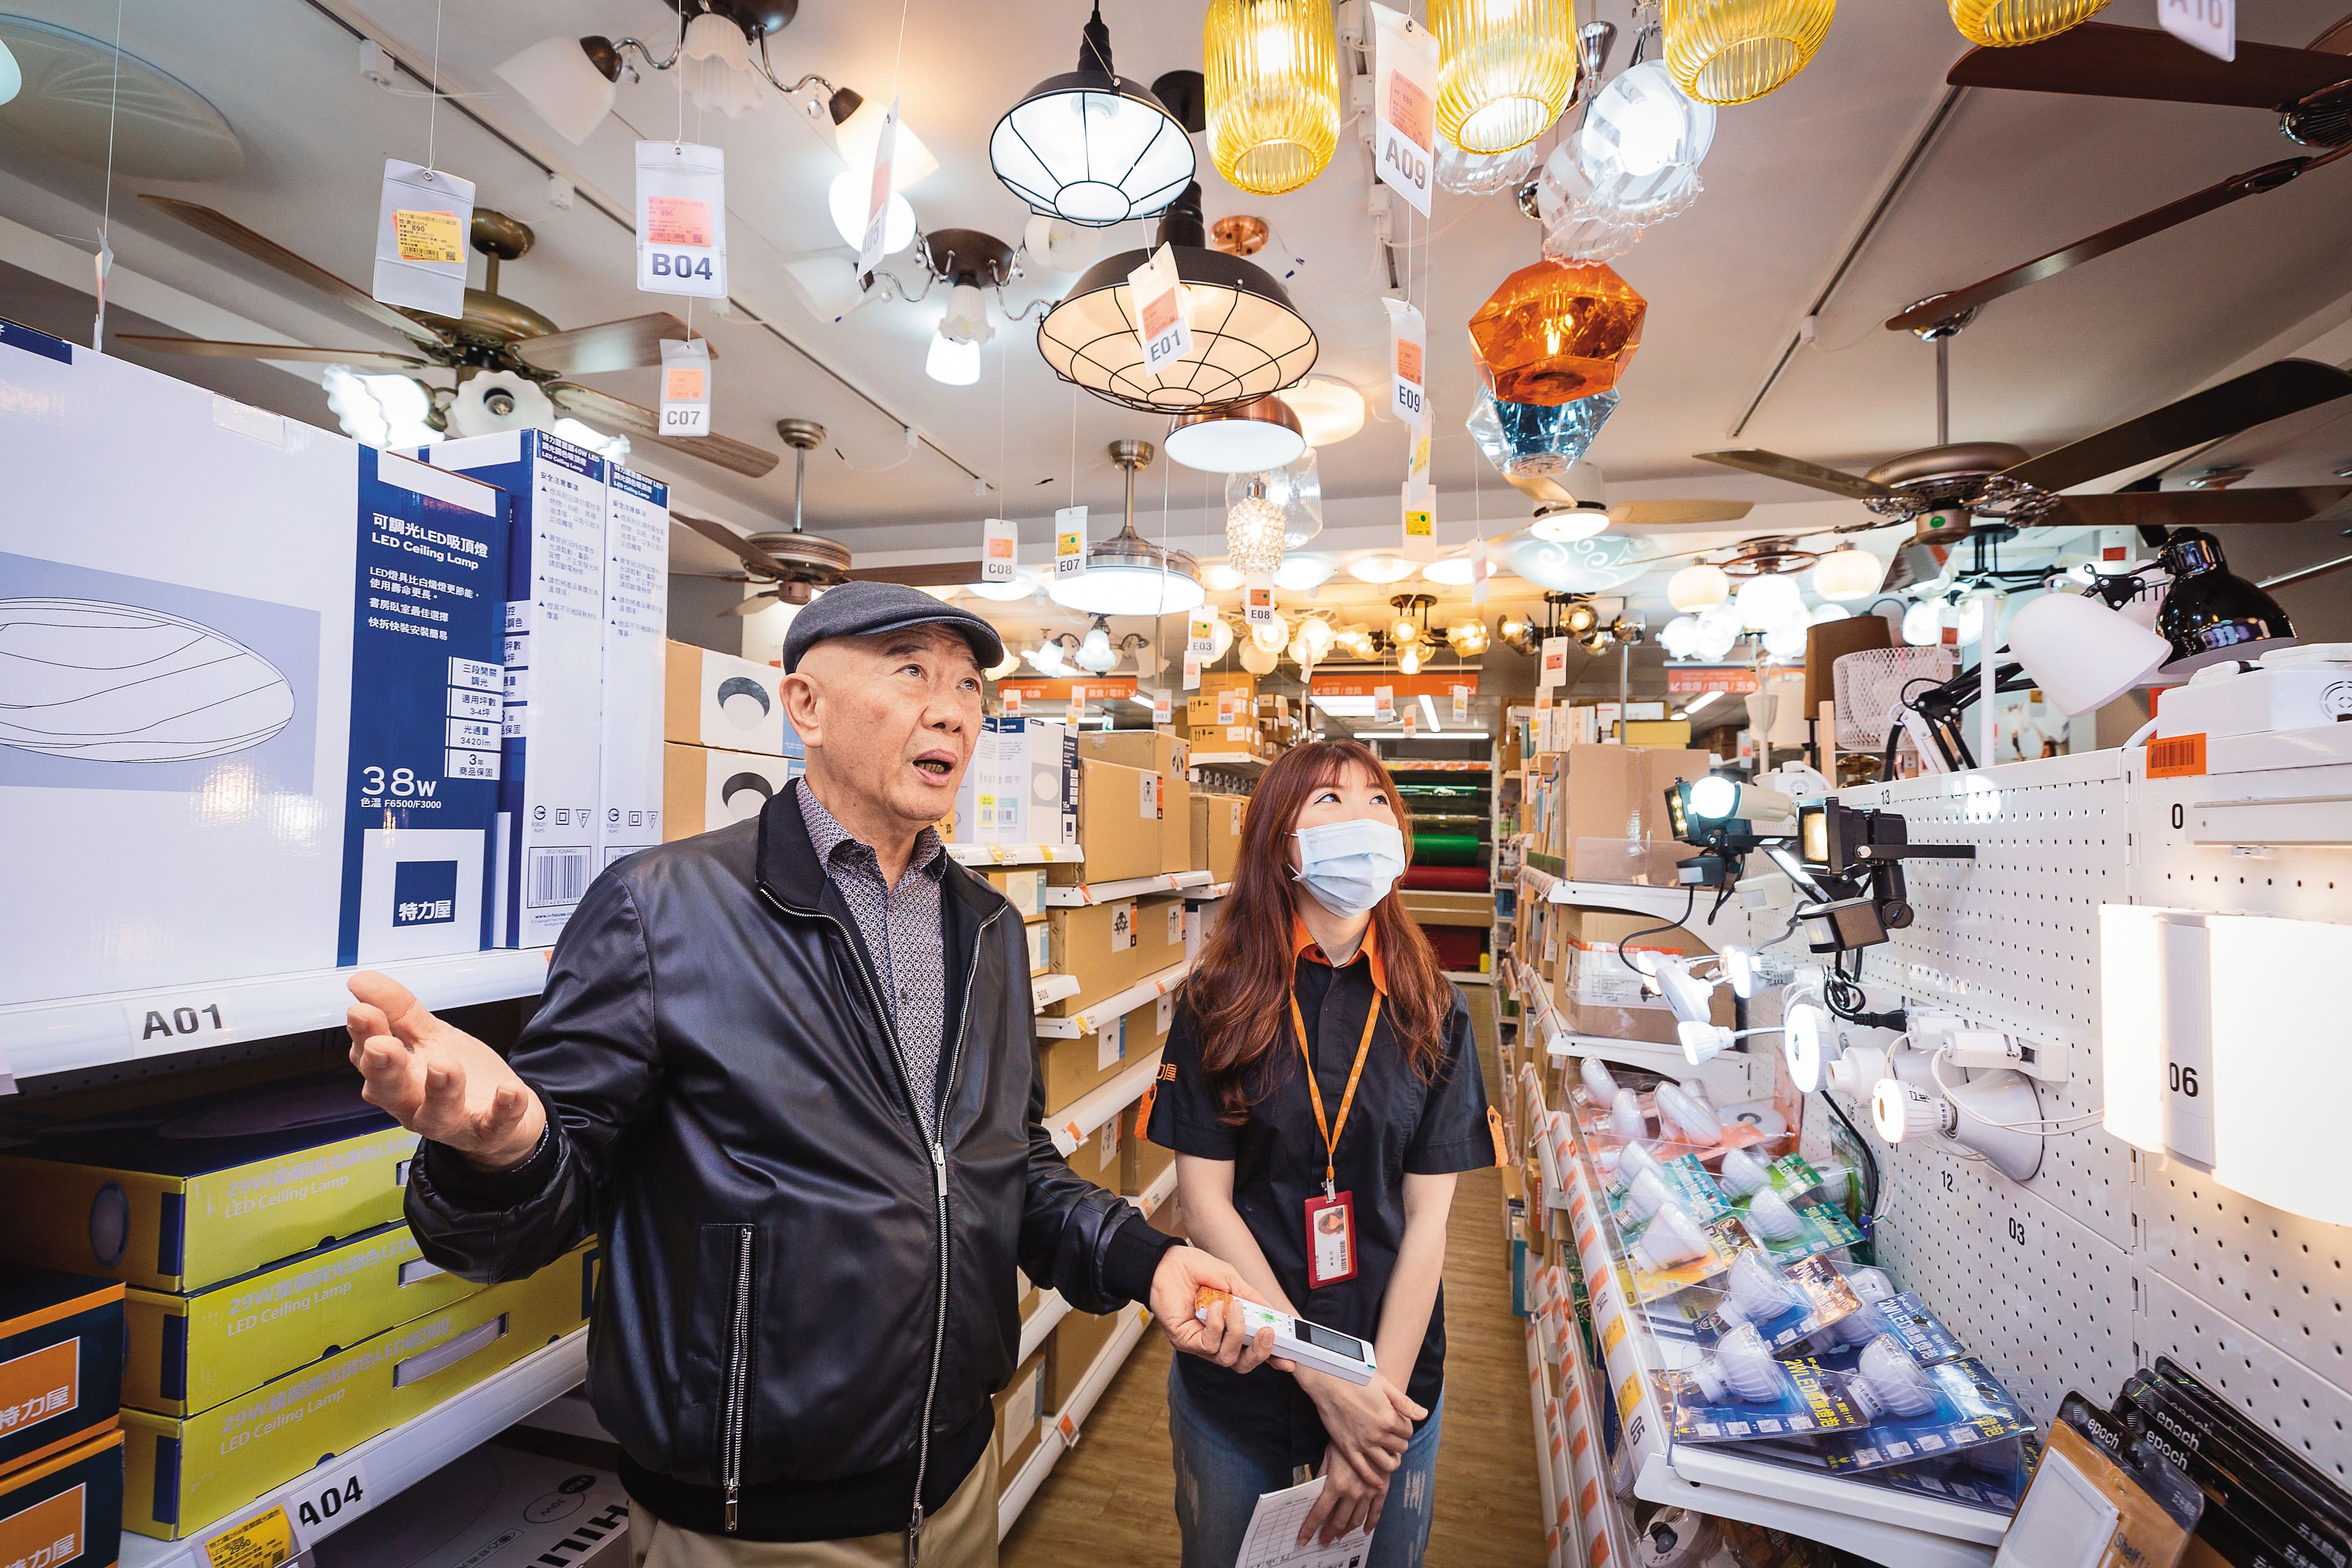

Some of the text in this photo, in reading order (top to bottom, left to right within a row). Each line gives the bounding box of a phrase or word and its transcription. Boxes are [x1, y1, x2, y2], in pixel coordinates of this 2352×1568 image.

[1385, 137, 1427, 190] A09
[652, 253, 713, 281] B04
[1150, 329, 1180, 362] E01
[1399, 385, 1420, 413] E09
[667, 411, 700, 426] C07
[372, 512, 488, 559] 可調光LED吸頂燈
[372, 532, 479, 571] LED Ceiling Lamp
[989, 564, 1012, 575] C08
[1060, 559, 1080, 572] E07
[369, 597, 449, 623] 書房臥室最佳選擇
[1251, 609, 1270, 620] E08
[368, 616, 448, 641] 快拆快裝安裝簡易
[1193, 641, 1212, 651] E03
[463, 663, 497, 678] 三段開關
[471, 676, 489, 688] 調光
[462, 693, 497, 707] 適用坪數
[470, 707, 490, 717] 3-4坪
[461, 736, 491, 747] 3420lm
[464, 725, 489, 736] 光通量
[459, 766, 493, 777] 商品保固
[469, 754, 484, 766] 3年
[360, 797, 442, 809] 色溫 F6500/F3000
[1882, 790, 1890, 805] 13
[398, 900, 451, 922] 特力屋
[142, 1003, 222, 1041] A01
[2169, 1062, 2199, 1097] 06
[1941, 1170, 1953, 1193] 12
[225, 1176, 349, 1219] LED Ceiling Lamp
[2009, 1216, 2026, 1246] 03
[227, 1281, 352, 1337] LED Ceiling Lamp
[1784, 1359, 1839, 1428] 2WLED感應燈泡
[220, 1389, 345, 1456] LED Ceiling Lamp
[1630, 1415, 1645, 1446] 05
[2087, 1418, 2119, 1449] epoch
[2157, 1411, 2199, 1451] epoch
[2146, 1430, 2188, 1470] epoch
[299, 1475, 363, 1527] A04
[541, 1498, 567, 1517] 30W
[228, 1539, 251, 1555] 2990
[2114, 1531, 2142, 1565] Shelf
